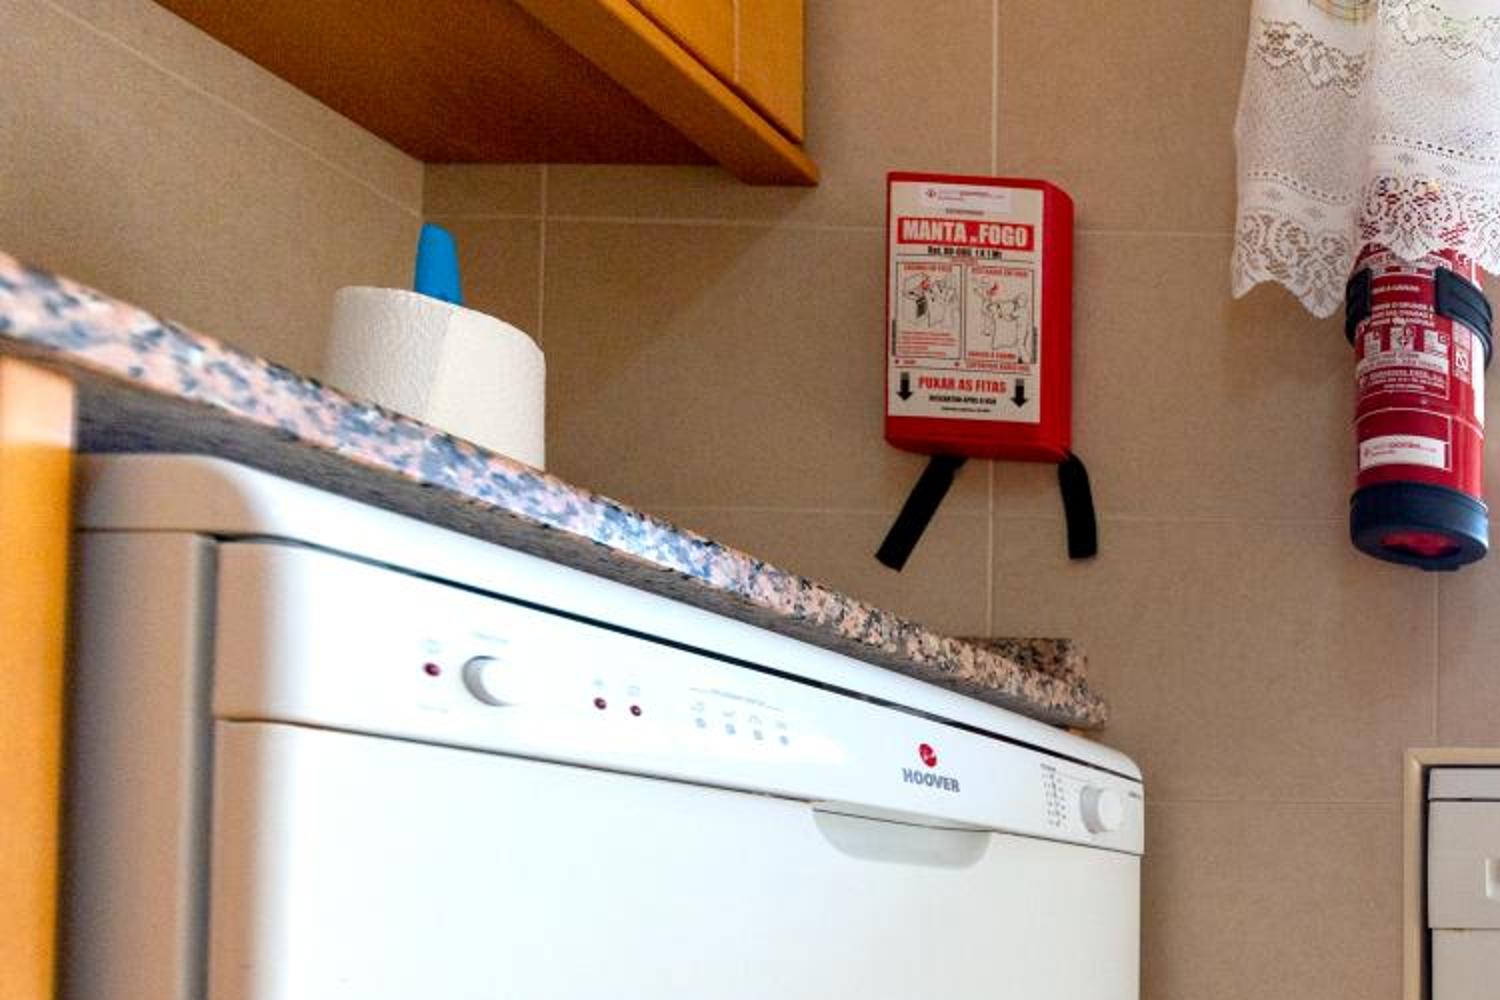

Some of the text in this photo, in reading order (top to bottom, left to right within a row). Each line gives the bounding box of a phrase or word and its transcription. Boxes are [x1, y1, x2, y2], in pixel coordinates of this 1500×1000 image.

[903, 219, 1027, 247] MANTA FOGO
[918, 376, 1006, 393] PUXAR AS FITAS
[902, 767, 961, 793] HOOVER
